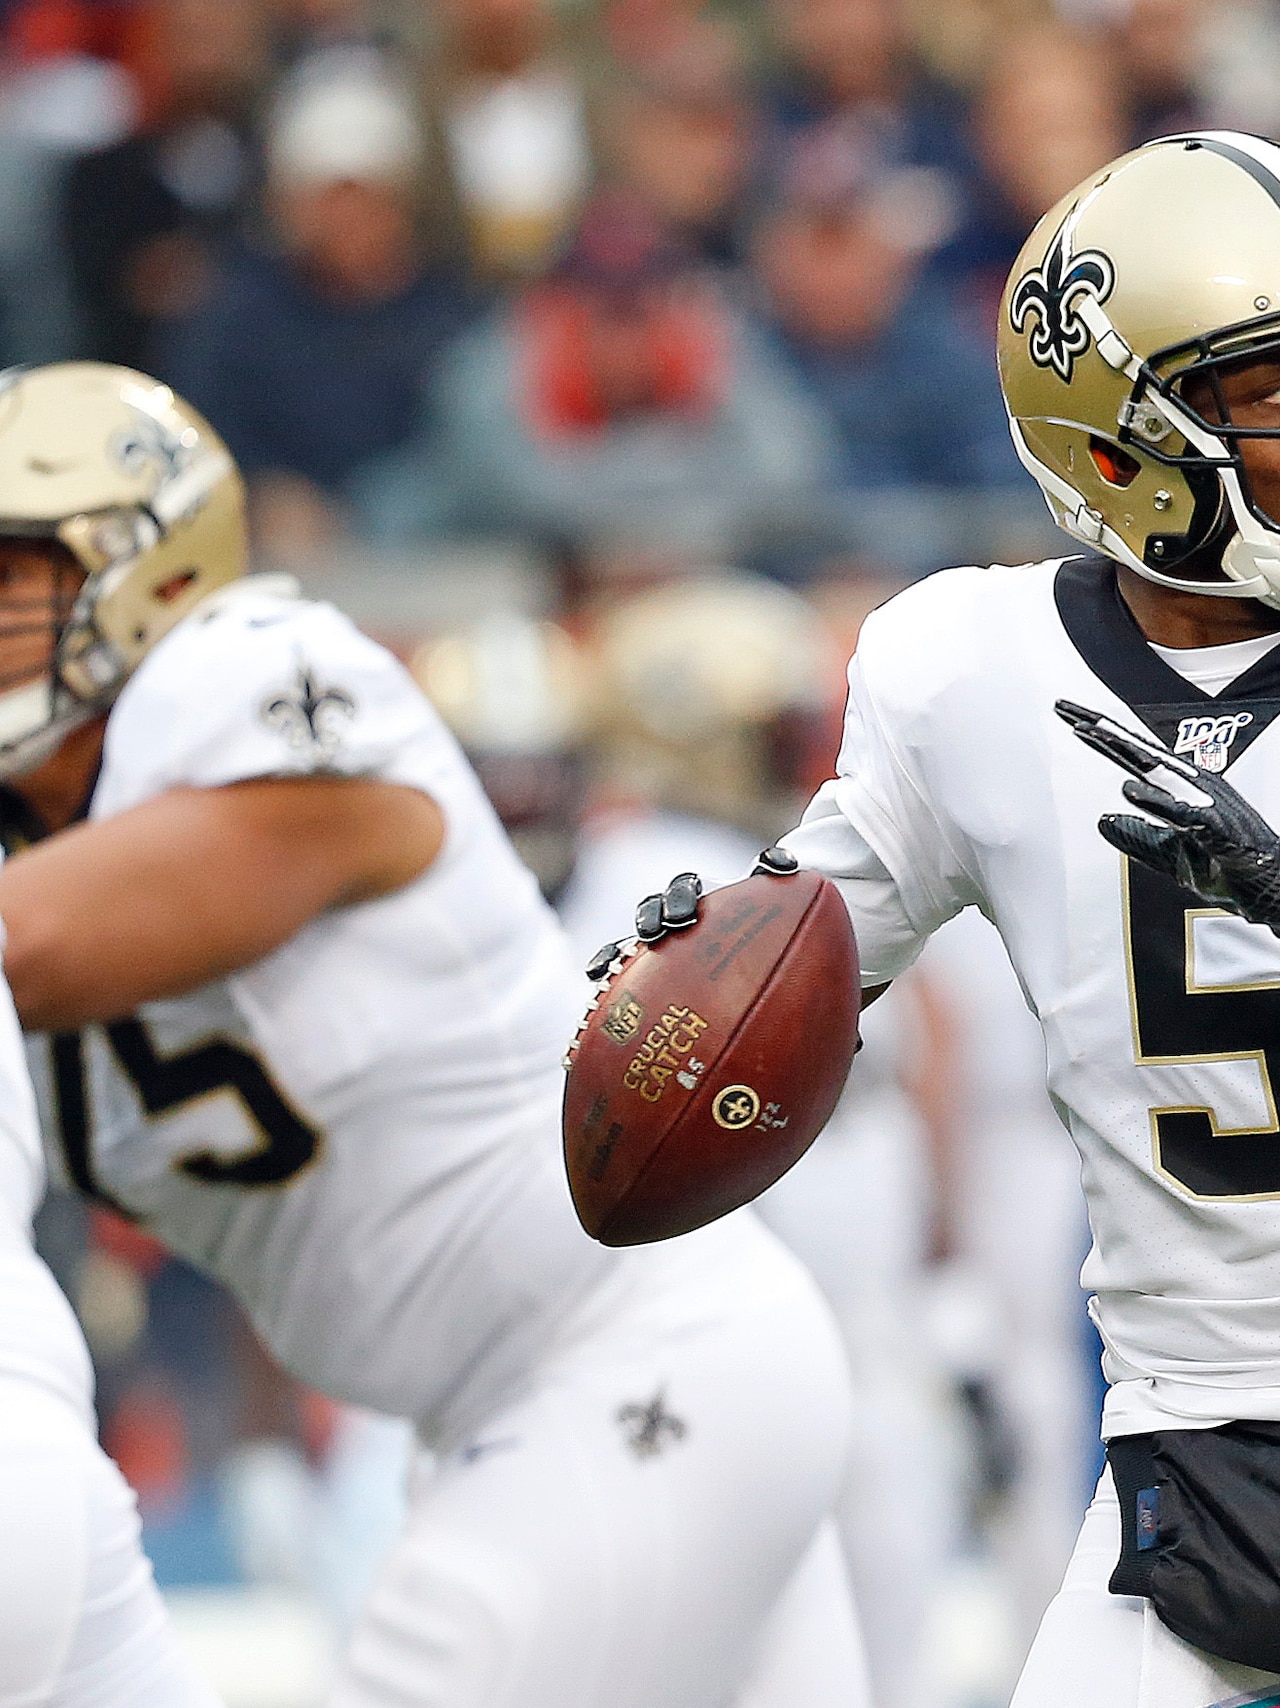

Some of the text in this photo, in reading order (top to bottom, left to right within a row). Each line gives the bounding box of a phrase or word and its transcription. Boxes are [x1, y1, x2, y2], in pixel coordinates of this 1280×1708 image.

[1200, 753, 1222, 768] NFL
[623, 1003, 690, 1090] CRUCIAL
[639, 1011, 708, 1103] CATCH
